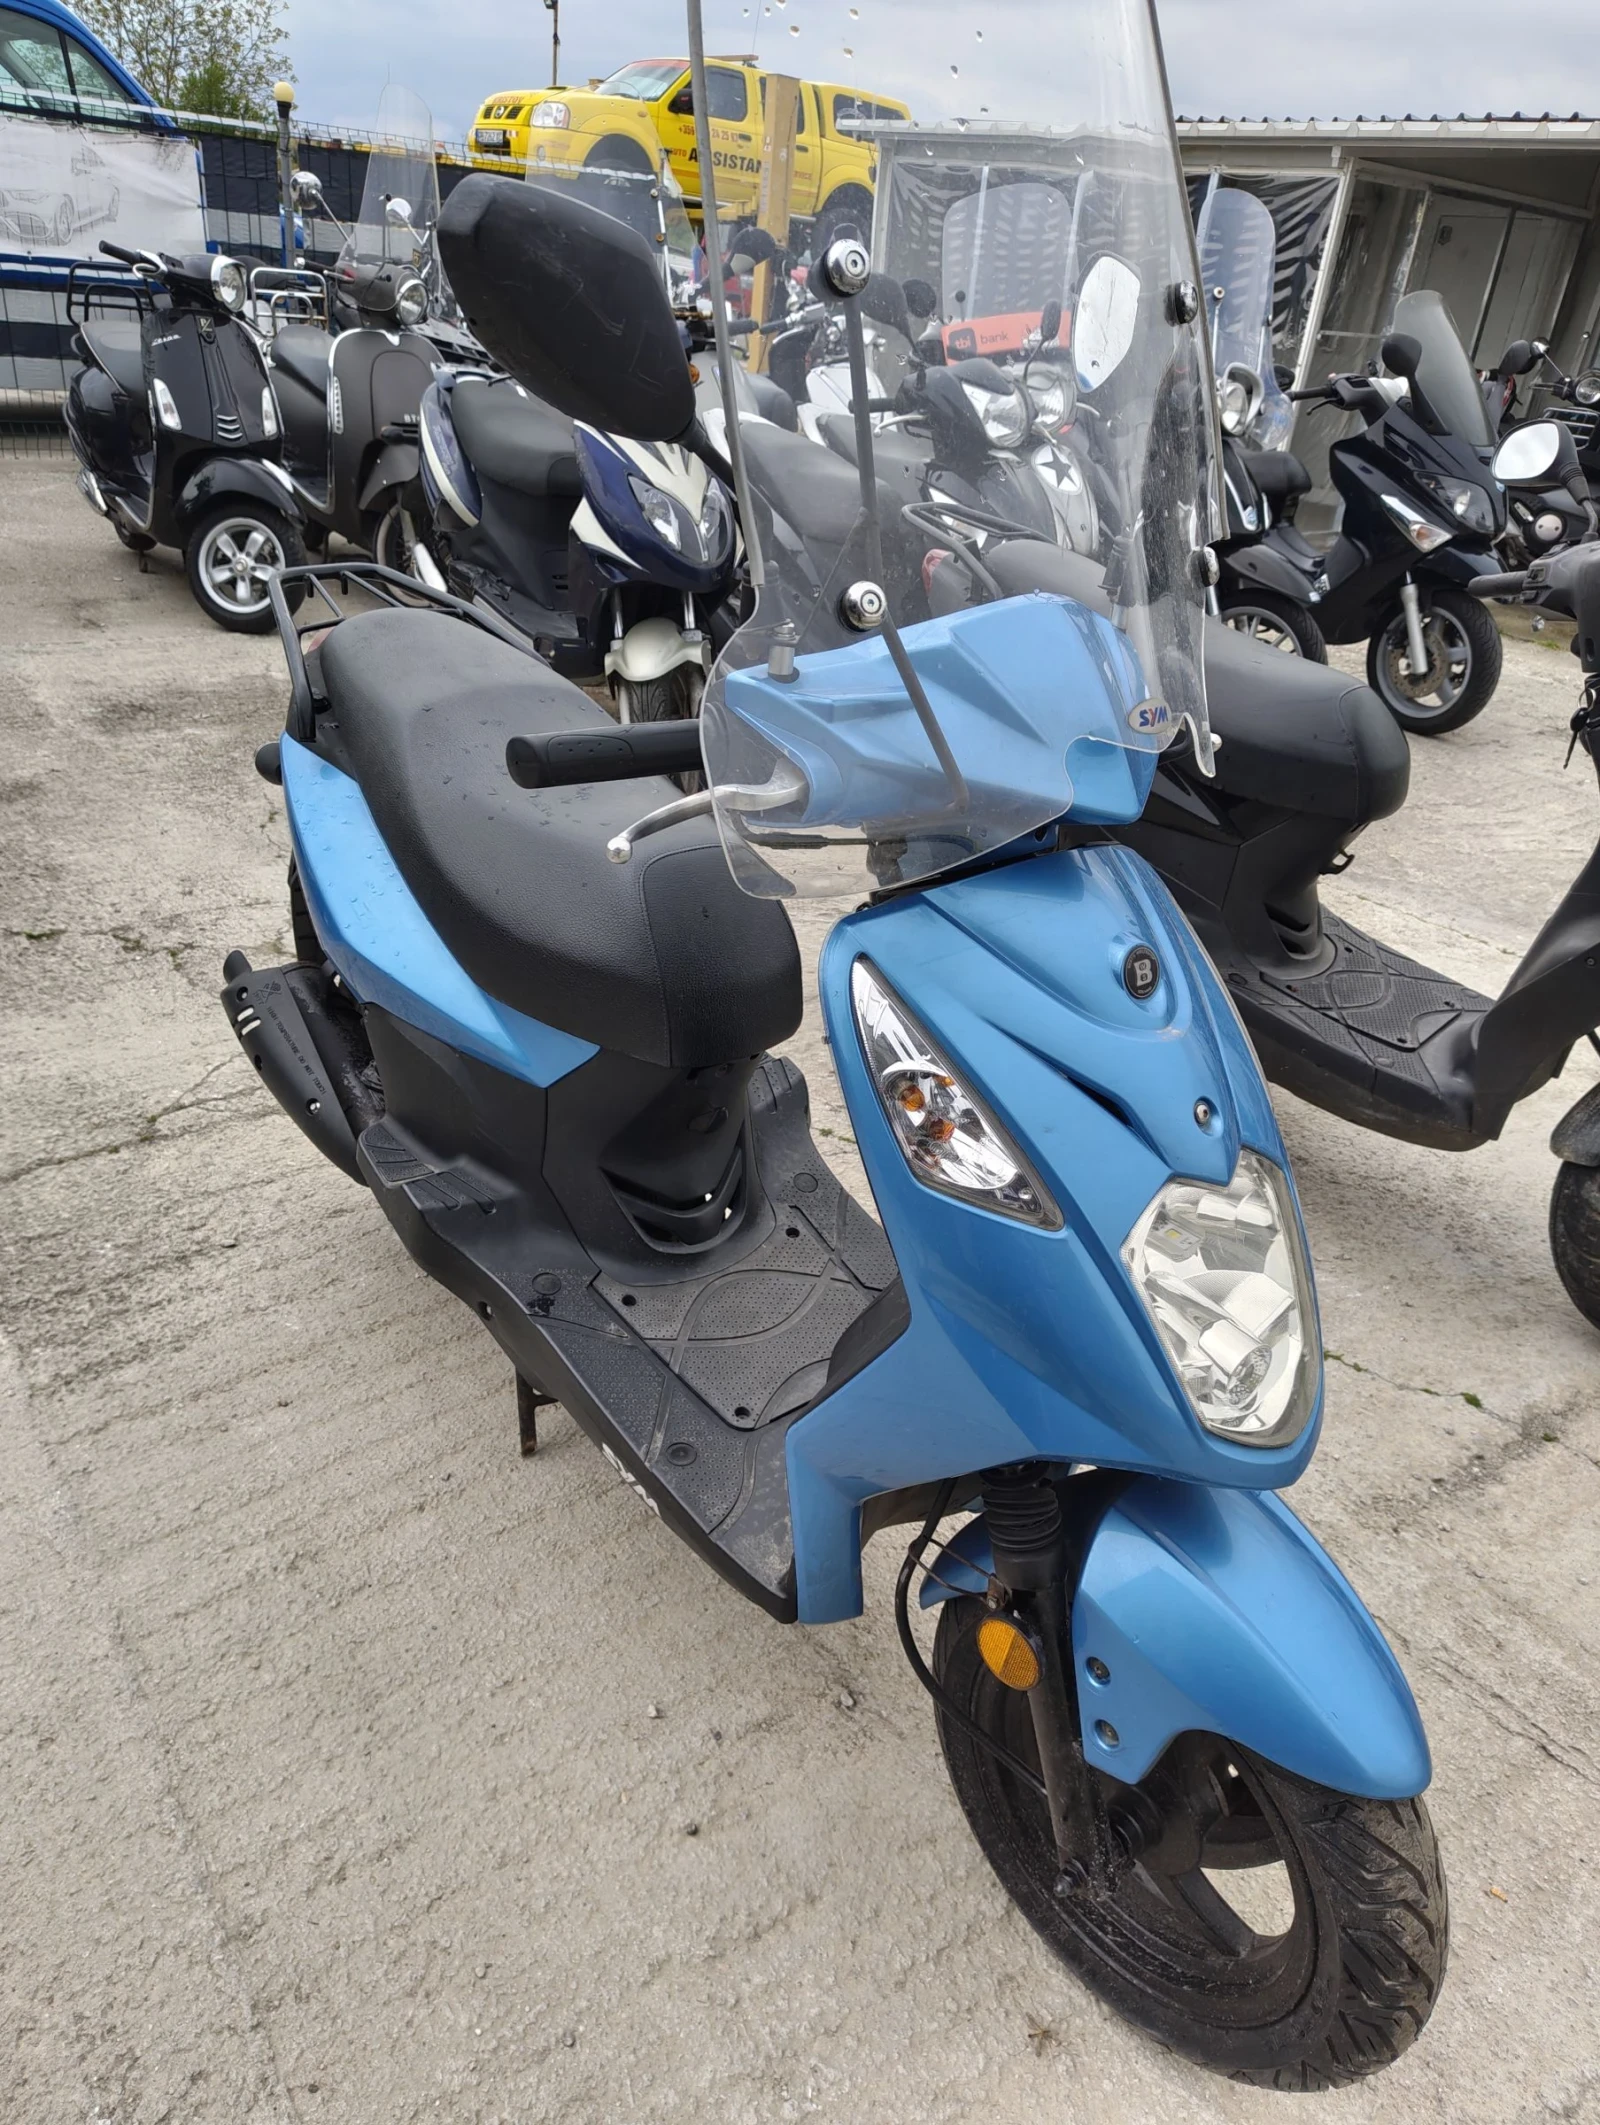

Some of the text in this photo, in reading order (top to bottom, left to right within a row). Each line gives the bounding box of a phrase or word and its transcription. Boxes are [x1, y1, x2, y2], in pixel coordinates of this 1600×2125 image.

[688, 148, 762, 174] ASISTAN
[980, 331, 1009, 345] bank
[1138, 705, 1169, 728] SYM
[298, 1055, 306, 1065] DO
[304, 1064, 315, 1076] NOT
[313, 1073, 327, 1095] TOUCH
